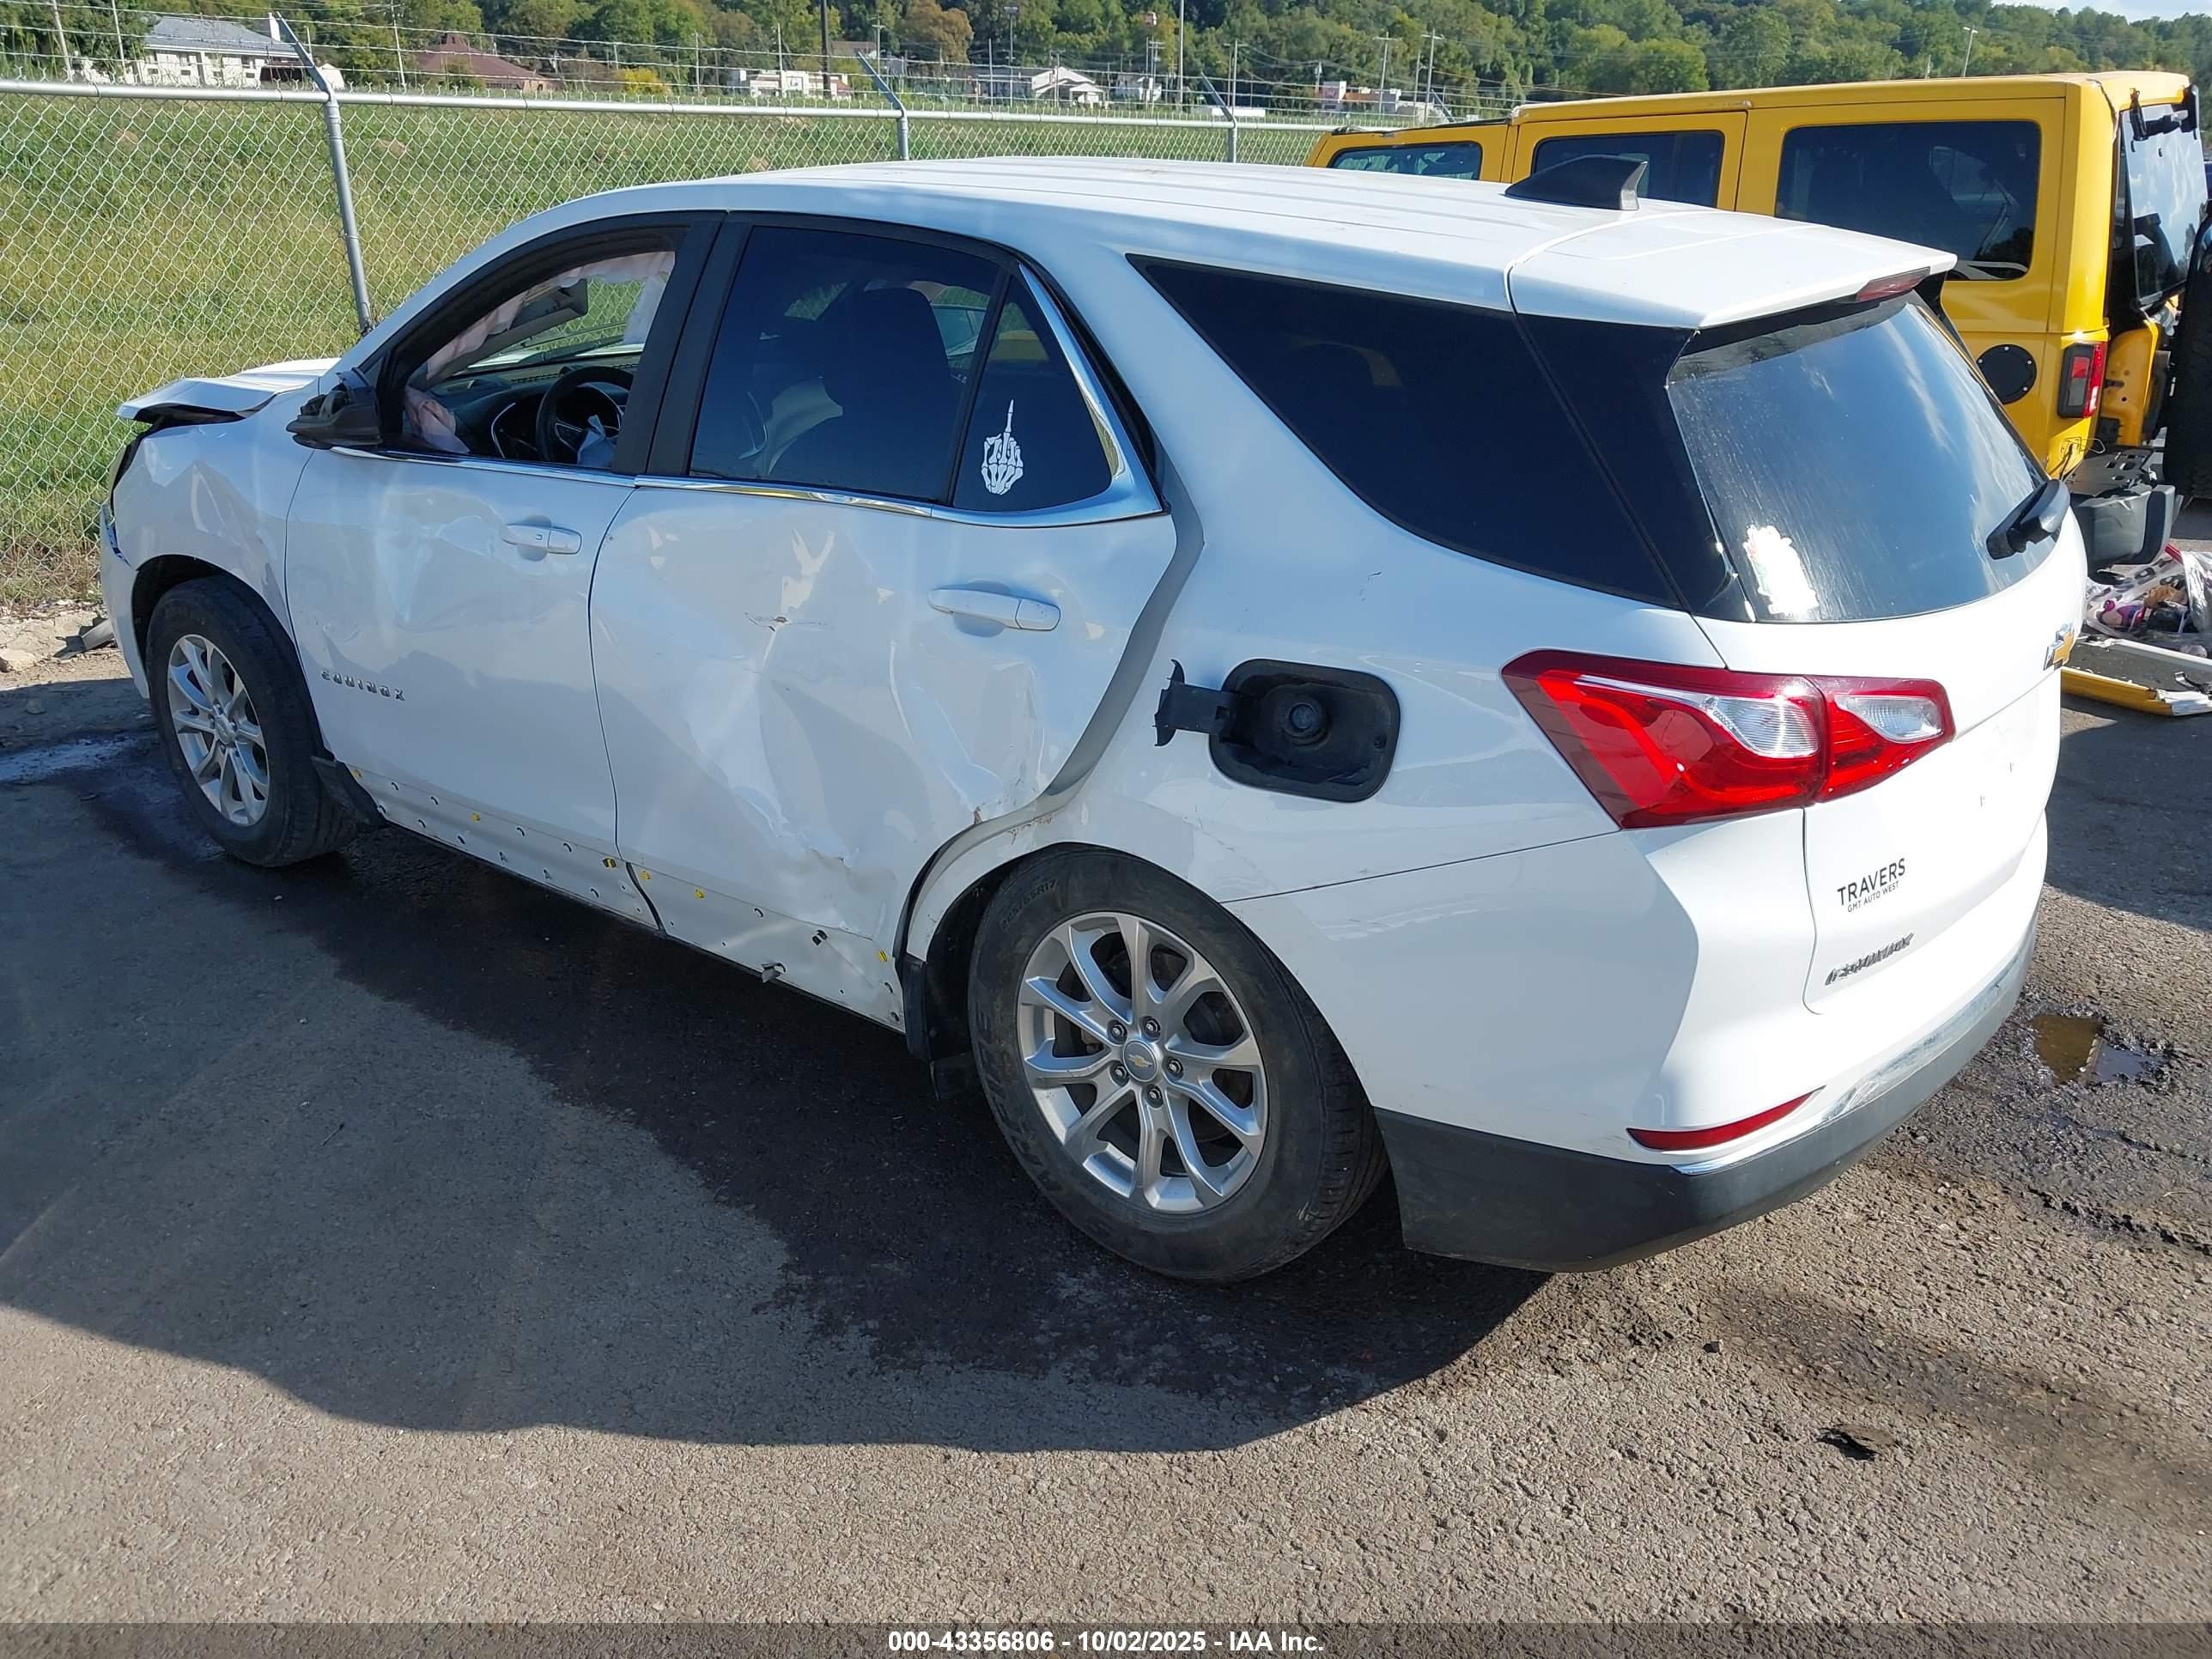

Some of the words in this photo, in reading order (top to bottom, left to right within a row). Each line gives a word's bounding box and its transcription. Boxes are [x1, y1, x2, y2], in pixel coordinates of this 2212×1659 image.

[321, 669, 406, 702] EQUINOX
[1837, 858, 1905, 905] TRAVERS
[1847, 899, 1862, 913] GMT
[1863, 890, 1881, 905] AUTO
[1882, 881, 1899, 896] WEST
